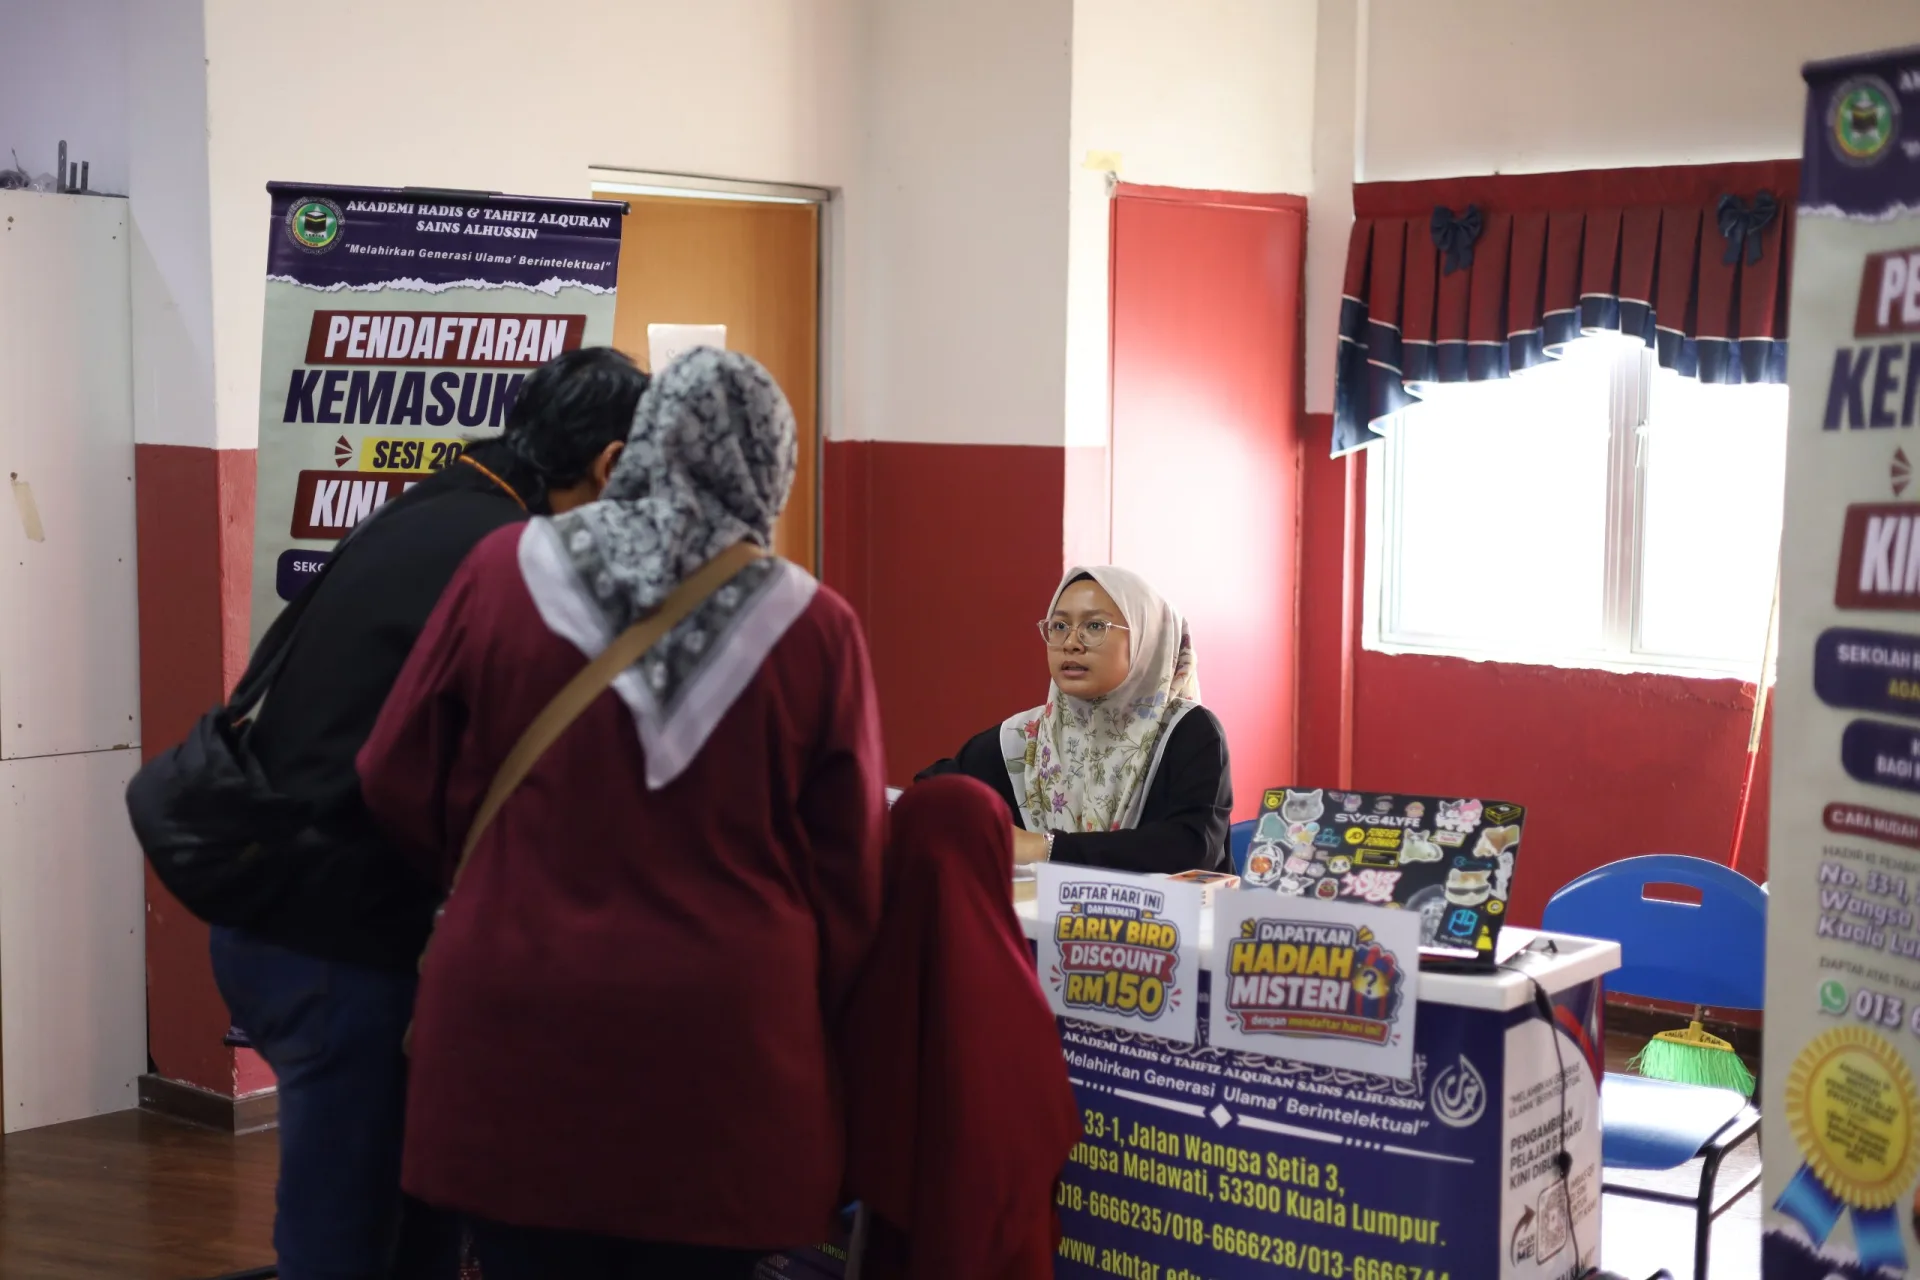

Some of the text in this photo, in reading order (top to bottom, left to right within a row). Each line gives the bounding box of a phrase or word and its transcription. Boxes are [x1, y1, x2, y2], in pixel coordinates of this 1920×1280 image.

[346, 201, 611, 229] AKADEMI HADIS & TAHFIZ ALQURAN
[416, 220, 538, 239] SAINS ALHUSSIN
[418, 249, 472, 261] Generasi
[324, 315, 568, 362] PENDAFTARAN
[373, 440, 424, 469] SESI
[309, 480, 388, 528] KINI
[1838, 643, 1911, 669] SEKOLAH
[1831, 809, 1872, 829] CARA
[1820, 863, 1861, 891] No.
[1062, 885, 1161, 909] DAFTAR HARI INI
[1087, 904, 1137, 918] DAN NIKMATI
[1820, 889, 1914, 928] Wangsa
[1058, 916, 1177, 950] EARLY BIRD
[1261, 923, 1350, 945] DAPATKAN
[1818, 914, 1886, 950] Kuala
[1070, 945, 1166, 975] DISCOUNT
[1231, 943, 1354, 979] HADIAH
[1067, 971, 1163, 1014] RM150
[1230, 975, 1351, 1011] MISTERI
[1855, 987, 1904, 1029] 013
[1251, 1015, 1287, 1029] dengan
[1288, 1017, 1341, 1031] mendaftar
[1343, 1021, 1363, 1034] hari
[1063, 1031, 1118, 1052] AKADEMI
[1119, 1046, 1159, 1062] HADIS
[1160, 1054, 1172, 1065] &
[1174, 1056, 1223, 1076] TAHFIZ
[1223, 1066, 1295, 1090] ALQURAN
[1296, 1080, 1344, 1099] SAINS
[1345, 1088, 1426, 1111] ALHUSSIN
[1144, 1069, 1216, 1098] Generasi
[1084, 1108, 1345, 1198] 33-1, Jalan Wangsa Setia 3,
[1510, 1138, 1552, 1171] PELAJAR
[1069, 1141, 1447, 1246] angsa Melawati, 53300 Kuala Lumpur.
[1509, 1167, 1531, 1191] KINI
